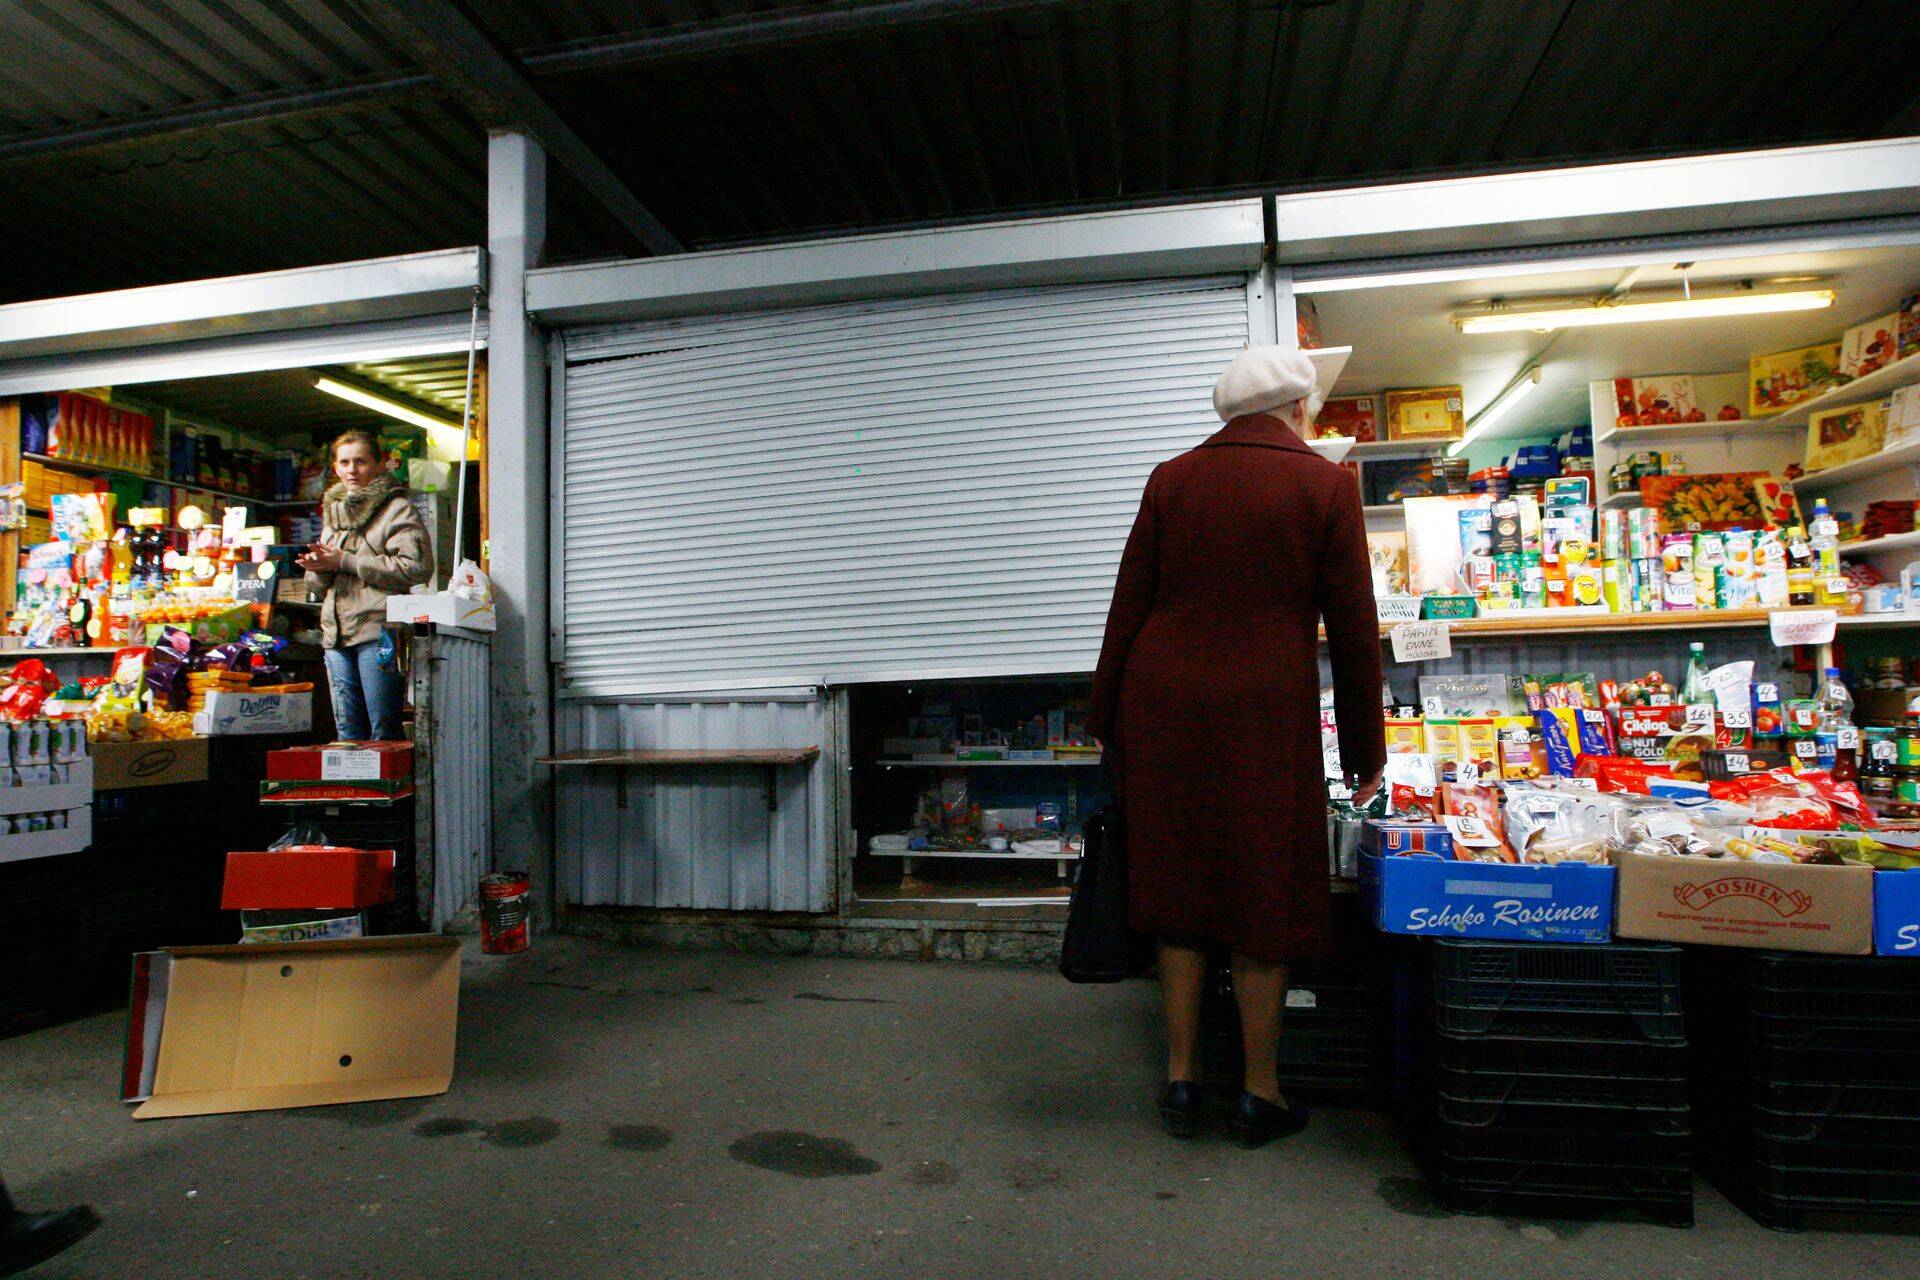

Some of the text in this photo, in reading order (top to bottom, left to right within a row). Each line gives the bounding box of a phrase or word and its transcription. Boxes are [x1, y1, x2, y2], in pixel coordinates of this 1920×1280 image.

[1405, 640, 1435, 651] ENNE
[239, 695, 281, 714] Delma
[1727, 711, 1748, 725] 35
[1633, 738, 1657, 748] NUT
[1633, 747, 1665, 757] GOLD
[1388, 832, 1399, 846] LU
[1702, 881, 1783, 905] ROSHEN
[1406, 899, 1600, 931] Schoko Rosinen
[1656, 910, 1725, 924] Кондитерская
[1790, 921, 1831, 931] ROSHEN
[1894, 924, 1920, 951] S
